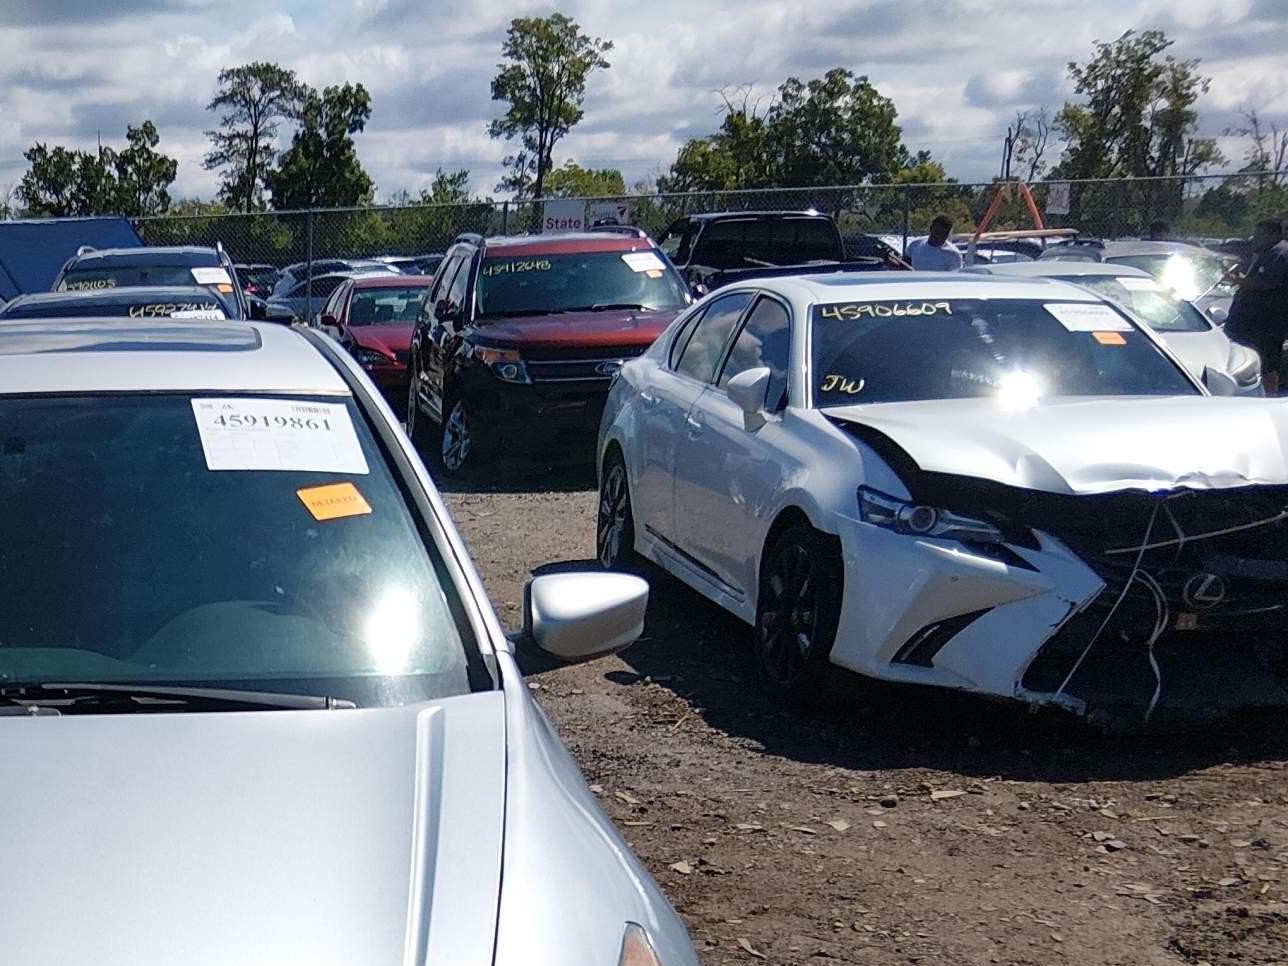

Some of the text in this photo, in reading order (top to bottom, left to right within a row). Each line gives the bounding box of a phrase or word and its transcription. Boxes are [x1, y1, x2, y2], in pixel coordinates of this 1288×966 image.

[546, 217, 581, 229] State
[822, 302, 953, 321] 45906609
[213, 413, 332, 431] 45919861
